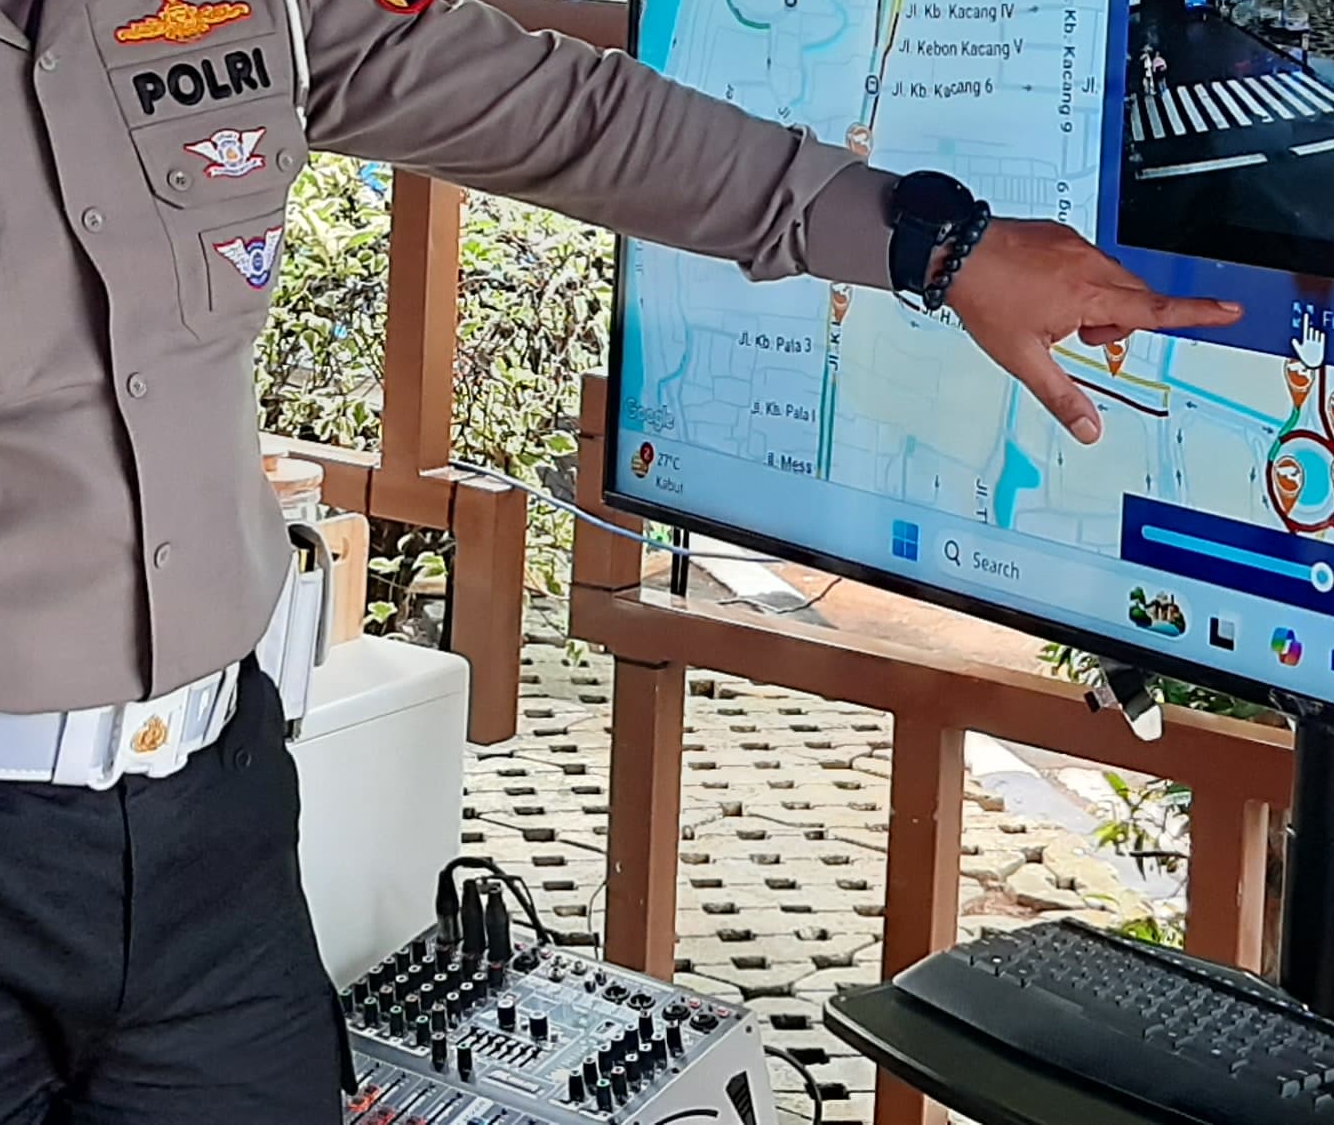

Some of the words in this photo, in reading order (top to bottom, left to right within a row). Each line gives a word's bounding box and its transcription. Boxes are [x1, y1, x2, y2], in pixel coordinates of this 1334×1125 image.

[949, 3, 997, 22] Kacang
[1001, 3, 1015, 19] IV
[917, 41, 957, 57] Kebon
[961, 41, 1010, 60] Kacang
[1014, 39, 1023, 54] V
[132, 48, 271, 115] POLRI
[934, 79, 980, 98] Kacang
[985, 78, 993, 94] 6
[1058, 46, 1076, 117] Kacang
[1082, 77, 1098, 94] Jl.
[1059, 122, 1073, 133] 9
[776, 337, 801, 354] Pala
[805, 338, 812, 353] 3
[786, 404, 809, 421] Pala
[781, 455, 812, 474] Mess
[973, 552, 1020, 579] Search
